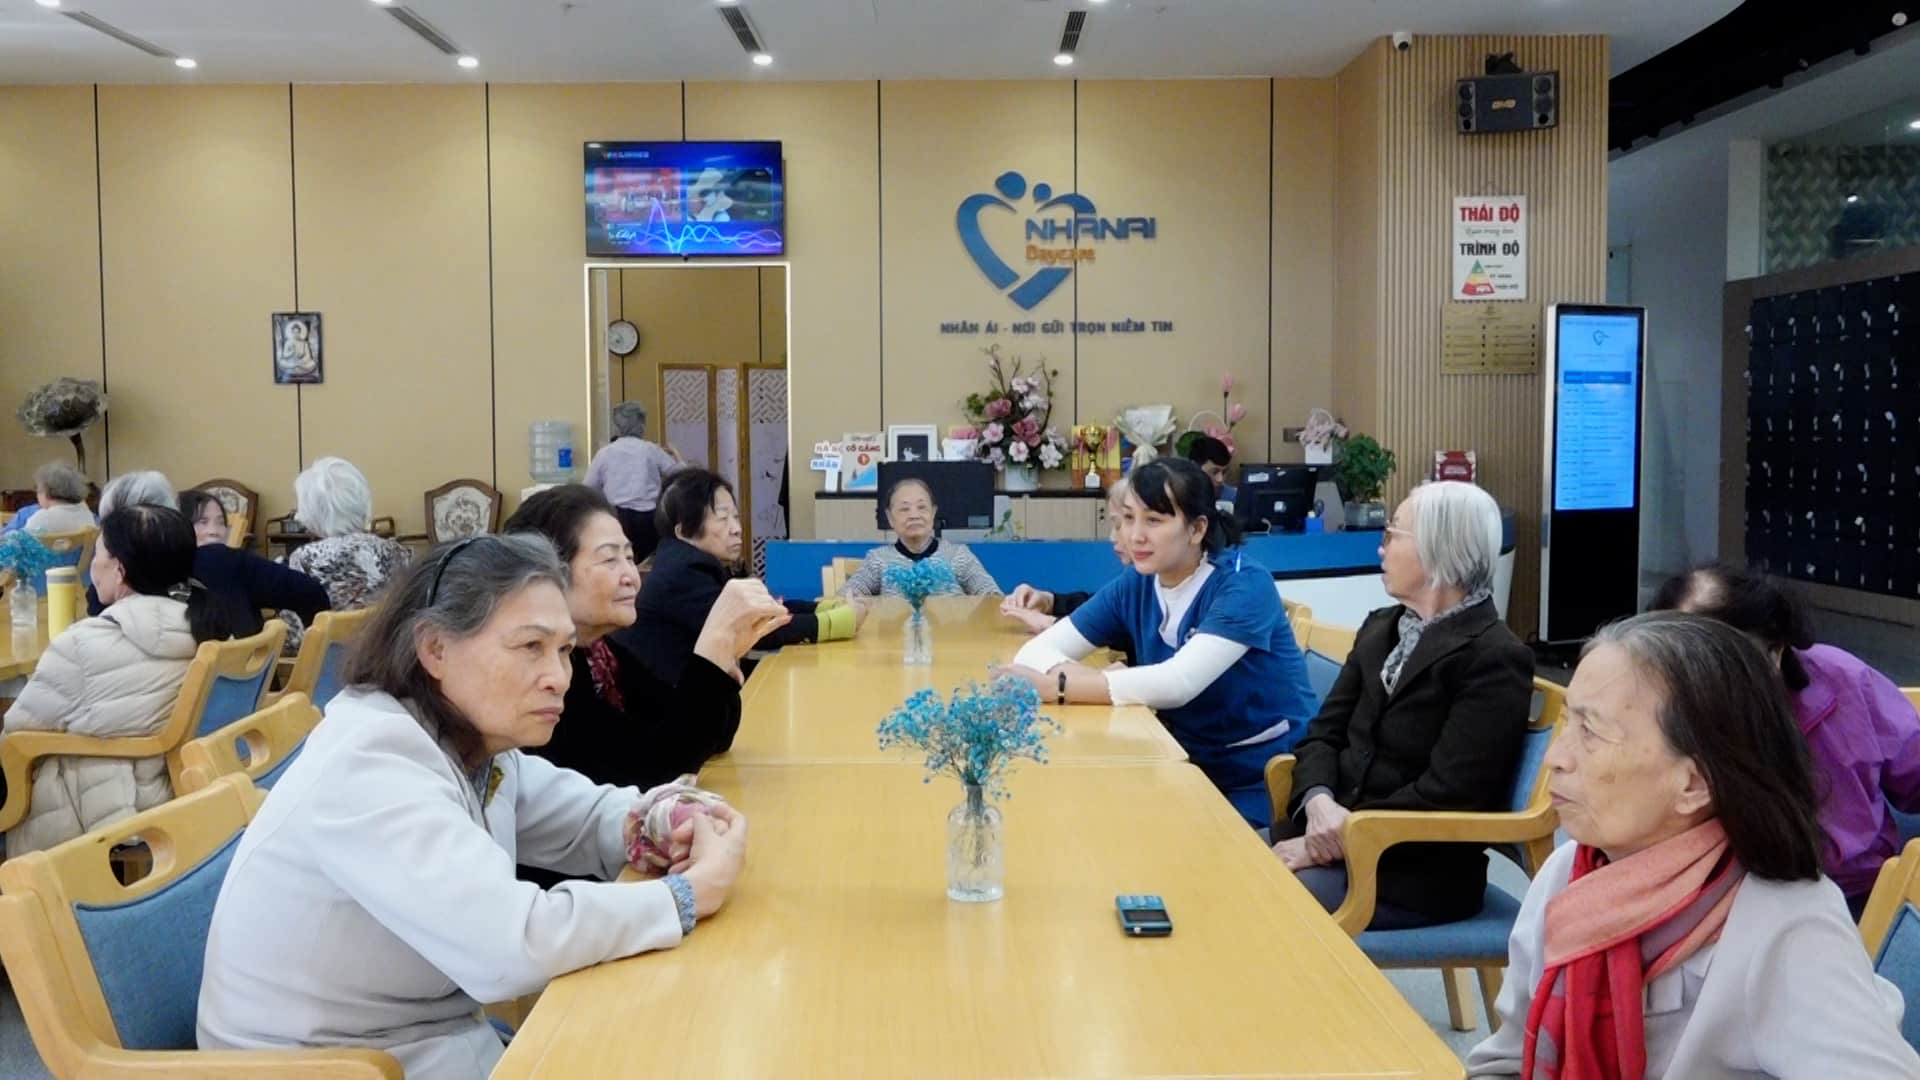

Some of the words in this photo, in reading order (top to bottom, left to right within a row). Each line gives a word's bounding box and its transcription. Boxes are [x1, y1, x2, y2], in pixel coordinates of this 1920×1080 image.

[1460, 203, 1493, 222] THÁI
[1499, 202, 1520, 223] ĐỘ
[1025, 245, 1096, 263] Daycare
[1460, 240, 1497, 256] TRÌNH
[940, 320, 979, 334] NHÂN
[985, 320, 998, 334] ÁI
[1070, 321, 1106, 335] TRỌN
[1151, 320, 1173, 332] TIN
